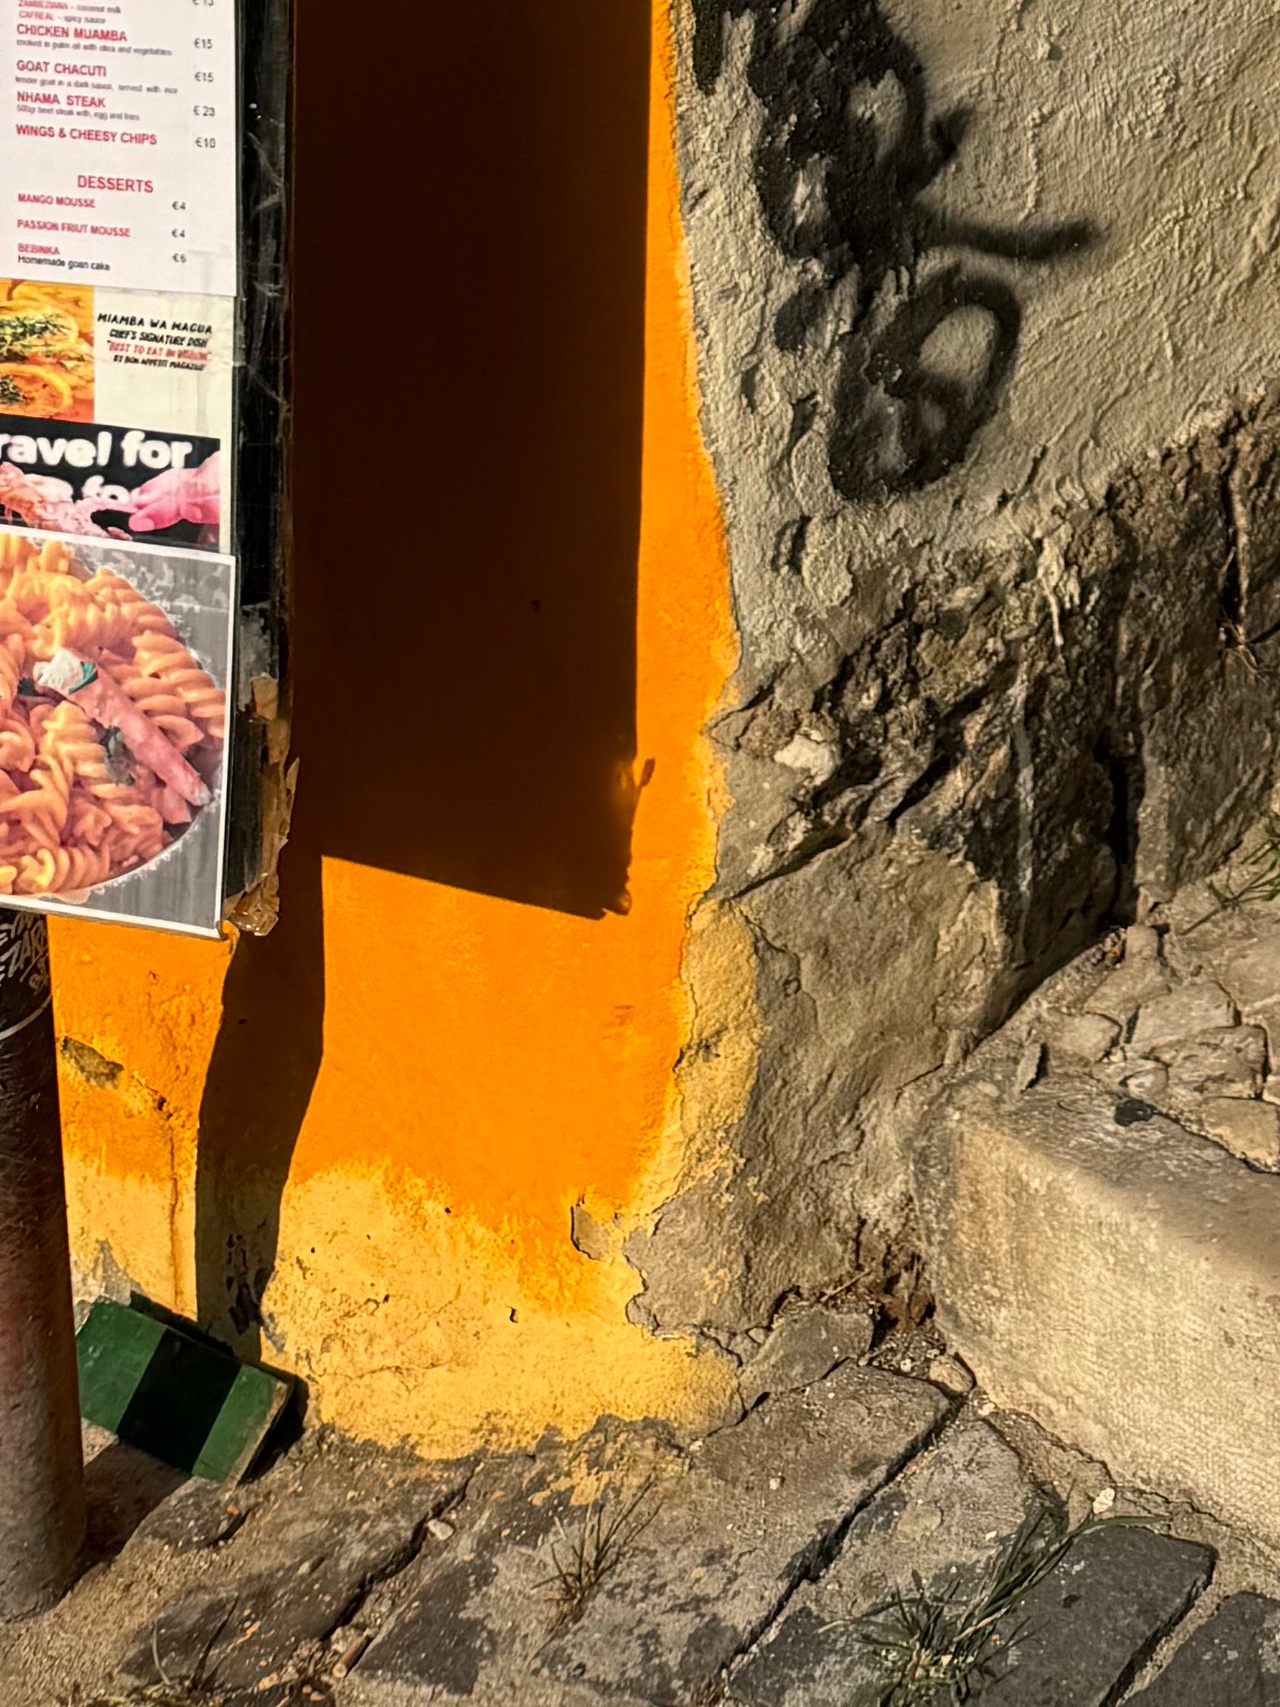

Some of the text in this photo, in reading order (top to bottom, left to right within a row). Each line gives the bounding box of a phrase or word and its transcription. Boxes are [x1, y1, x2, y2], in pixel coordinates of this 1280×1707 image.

[16, 23, 128, 42] CHICKEN MUAMBA
[16, 60, 107, 77] GOAT CHACUTI
[17, 91, 106, 109] NHAMA STEAK
[16, 123, 157, 145] WINGS & CHEESY CHIPS
[77, 175, 154, 193] DESSERTS
[18, 193, 96, 208] MANGO MOUSSE
[17, 219, 59, 231] PASSION
[90, 225, 131, 238] MOUSSE
[18, 254, 65, 267] Homemade
[90, 262, 110, 271] cake
[150, 318, 167, 330] WA
[133, 344, 145, 355] TO
[146, 346, 166, 357] EAT
[121, 430, 193, 470] for
